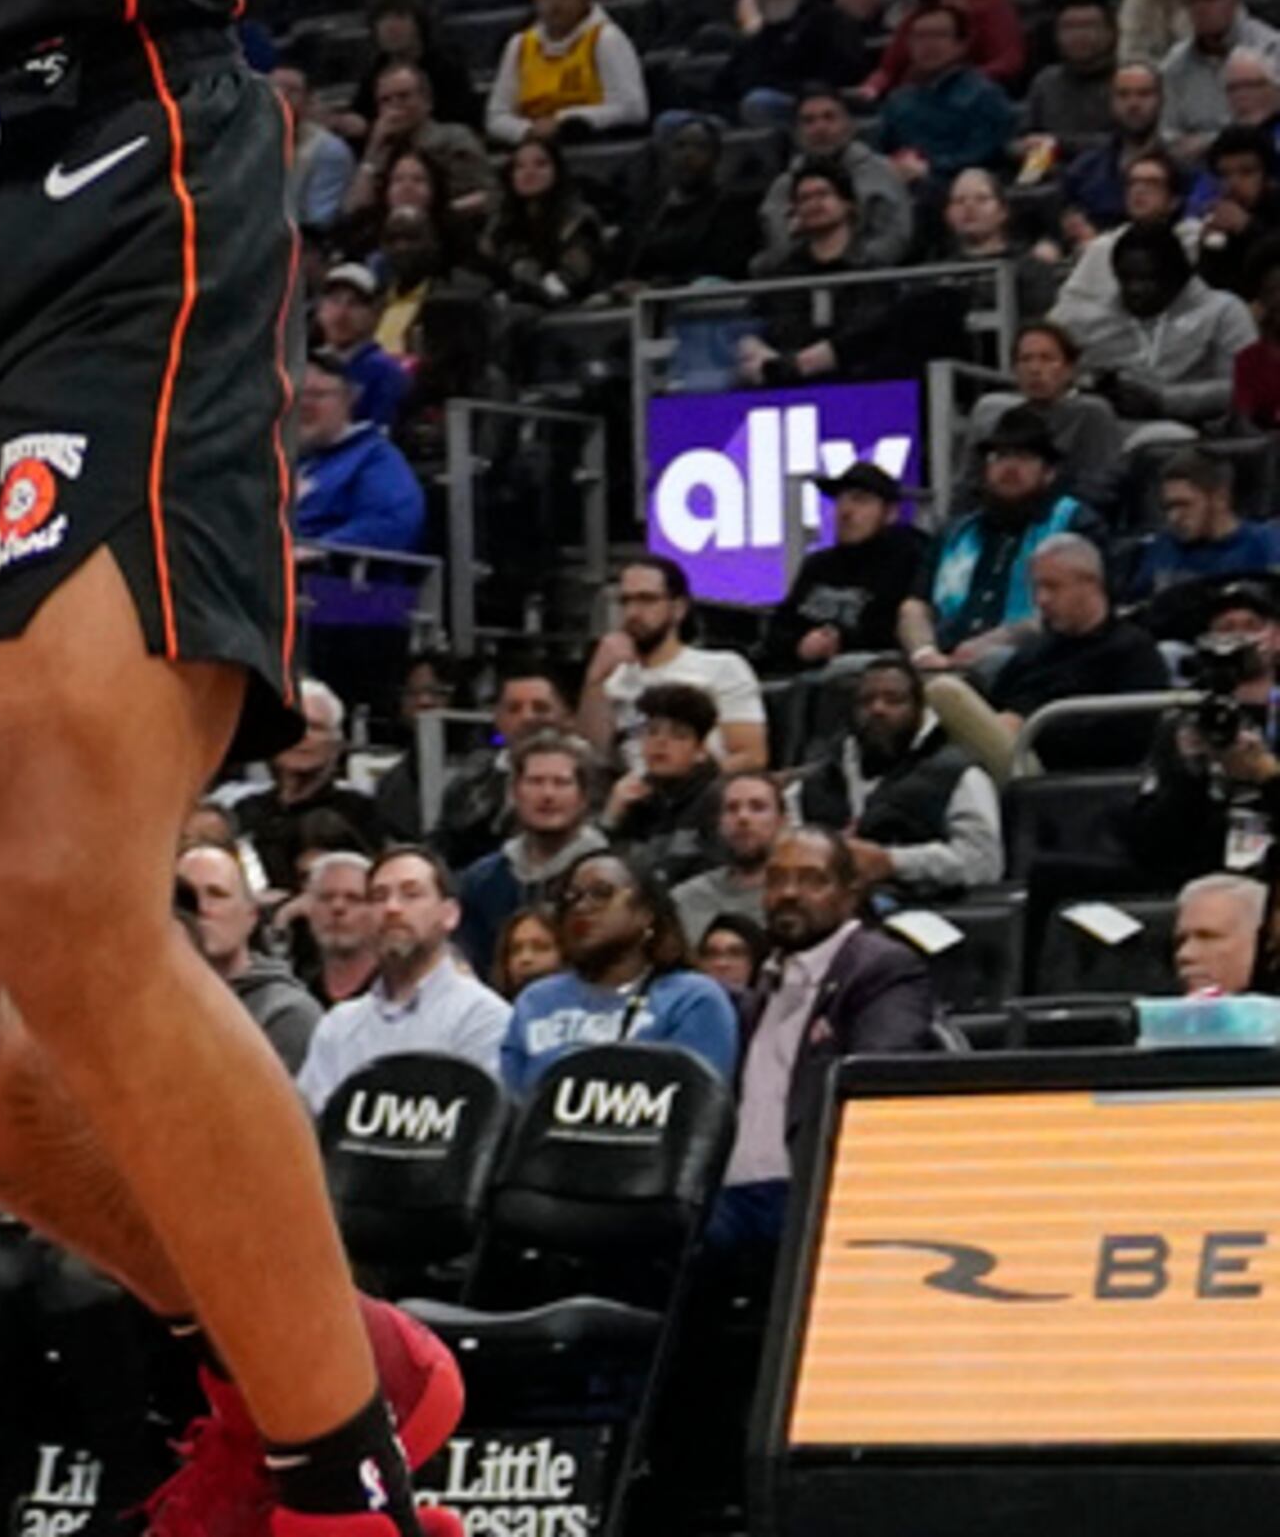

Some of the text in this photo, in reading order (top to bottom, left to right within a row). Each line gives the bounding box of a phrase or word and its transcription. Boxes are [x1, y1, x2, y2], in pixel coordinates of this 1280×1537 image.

[345, 1090, 467, 1142] UWM
[553, 1076, 680, 1128] UWM
[1094, 1230, 1269, 1301] BE
[445, 1437, 577, 1501] Little
